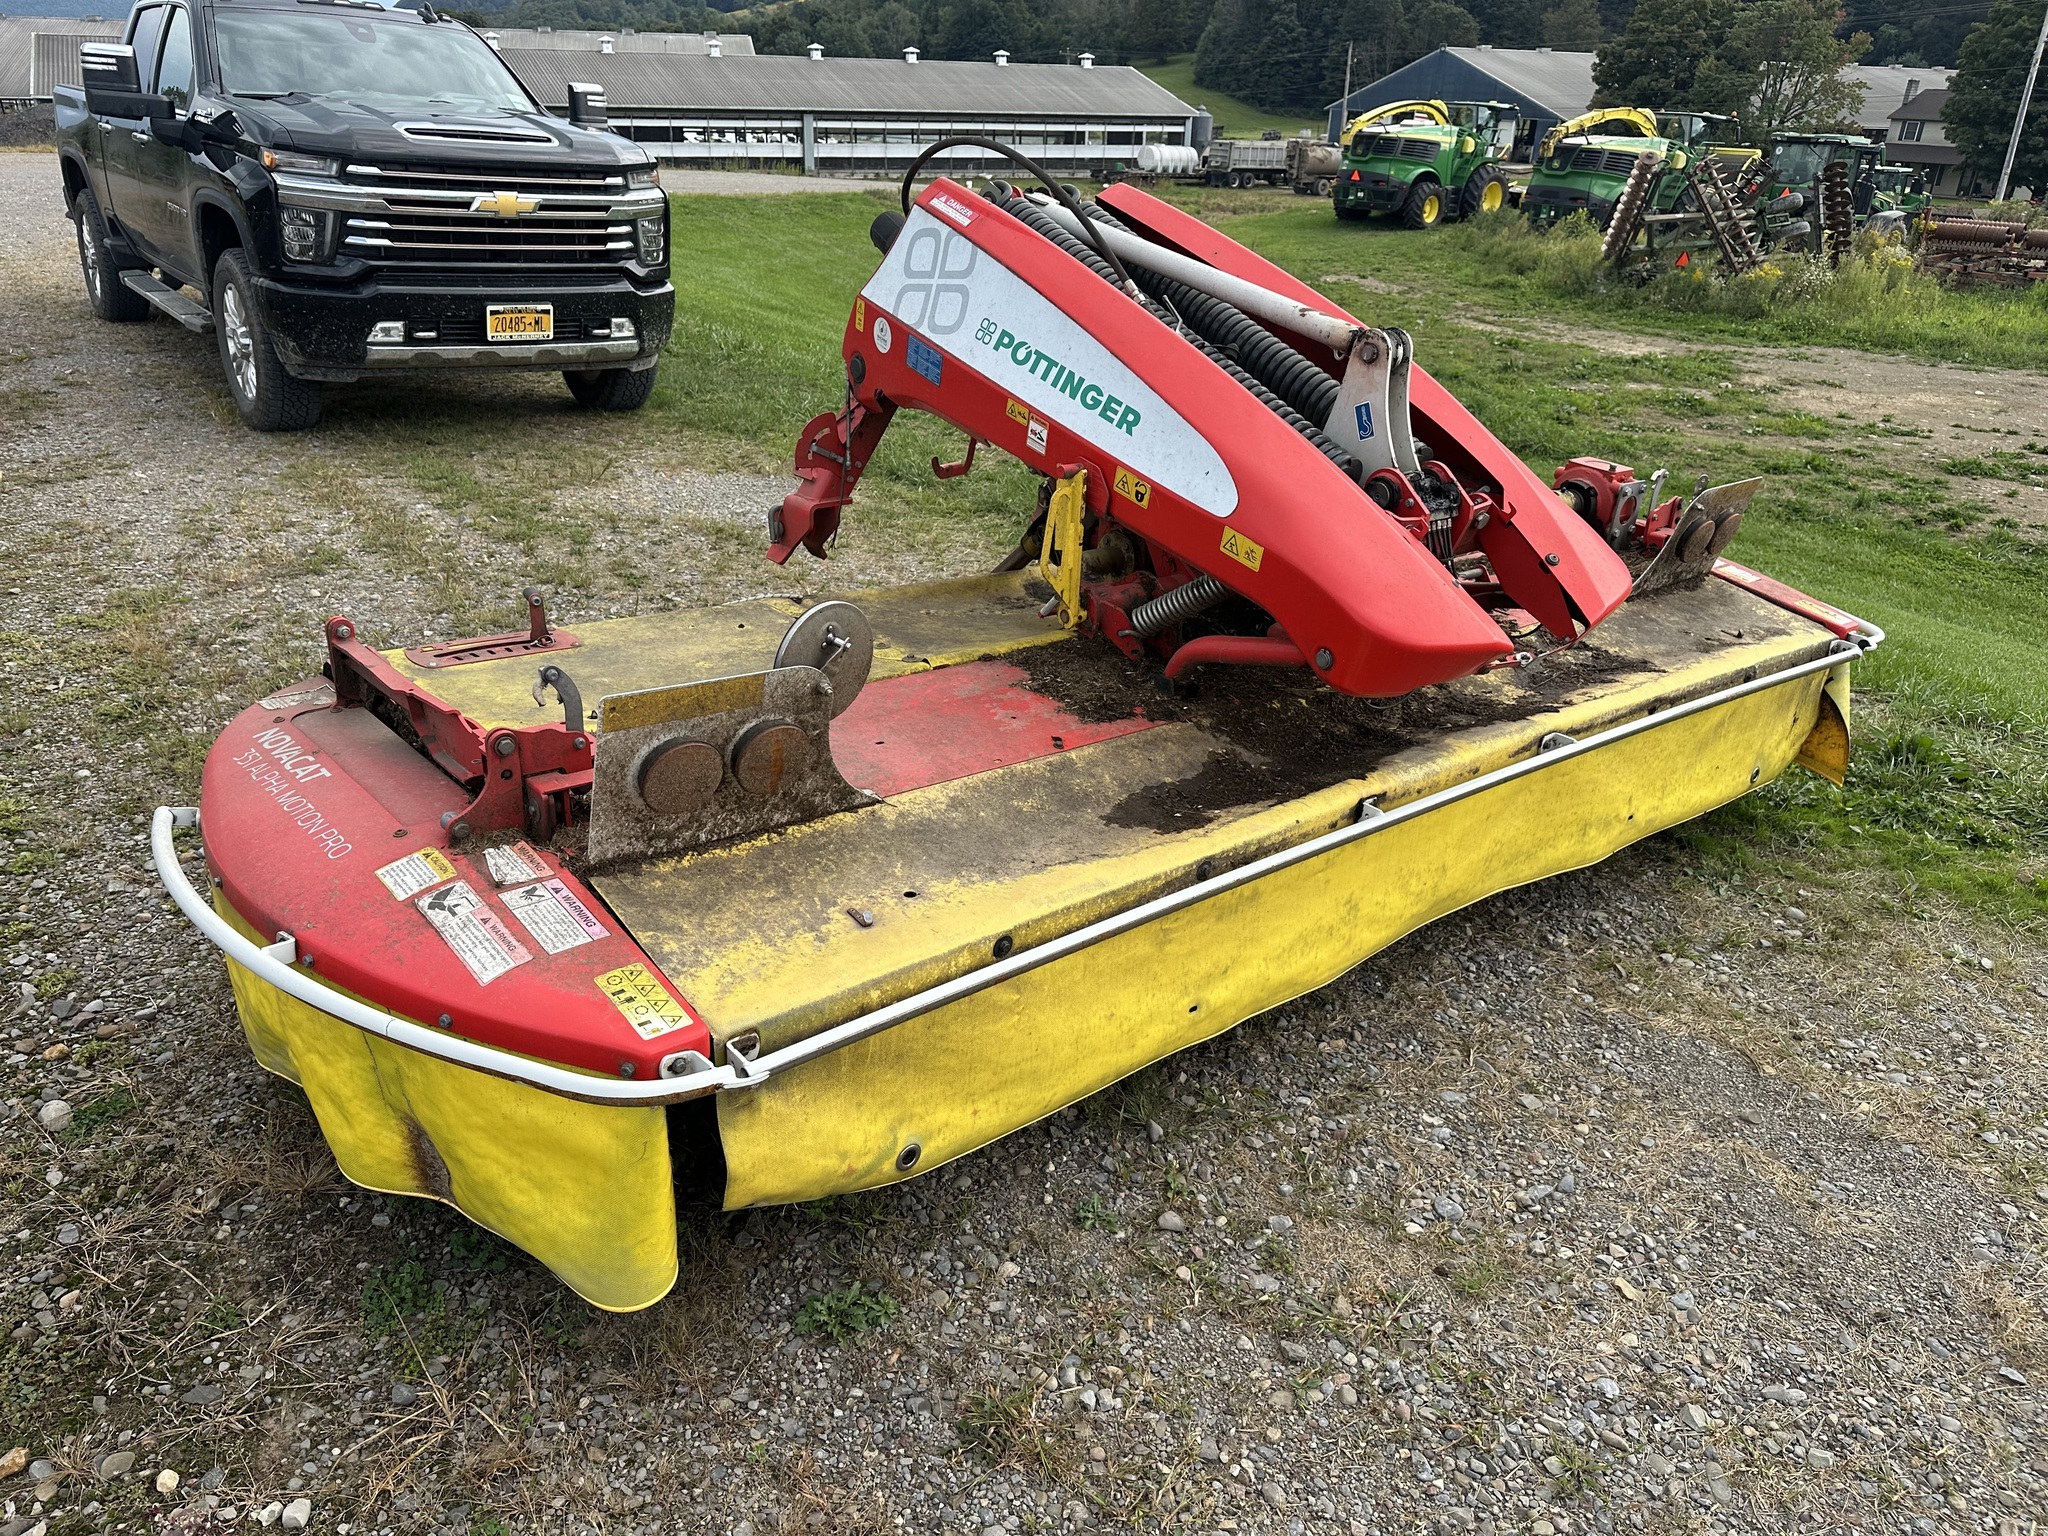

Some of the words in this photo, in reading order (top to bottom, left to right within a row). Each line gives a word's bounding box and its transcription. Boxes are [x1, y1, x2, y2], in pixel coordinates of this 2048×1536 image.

[946, 198, 973, 218] DANGER
[494, 316, 527, 333] 20485
[232, 747, 263, 768] 351
[252, 727, 332, 783] NOVACAT
[246, 762, 290, 796] ALPHA
[274, 789, 330, 835] MOTION
[312, 828, 353, 859] PRO
[517, 845, 546, 872] WARNING
[561, 893, 597, 928] WARNING
[489, 923, 517, 952] WARNING
